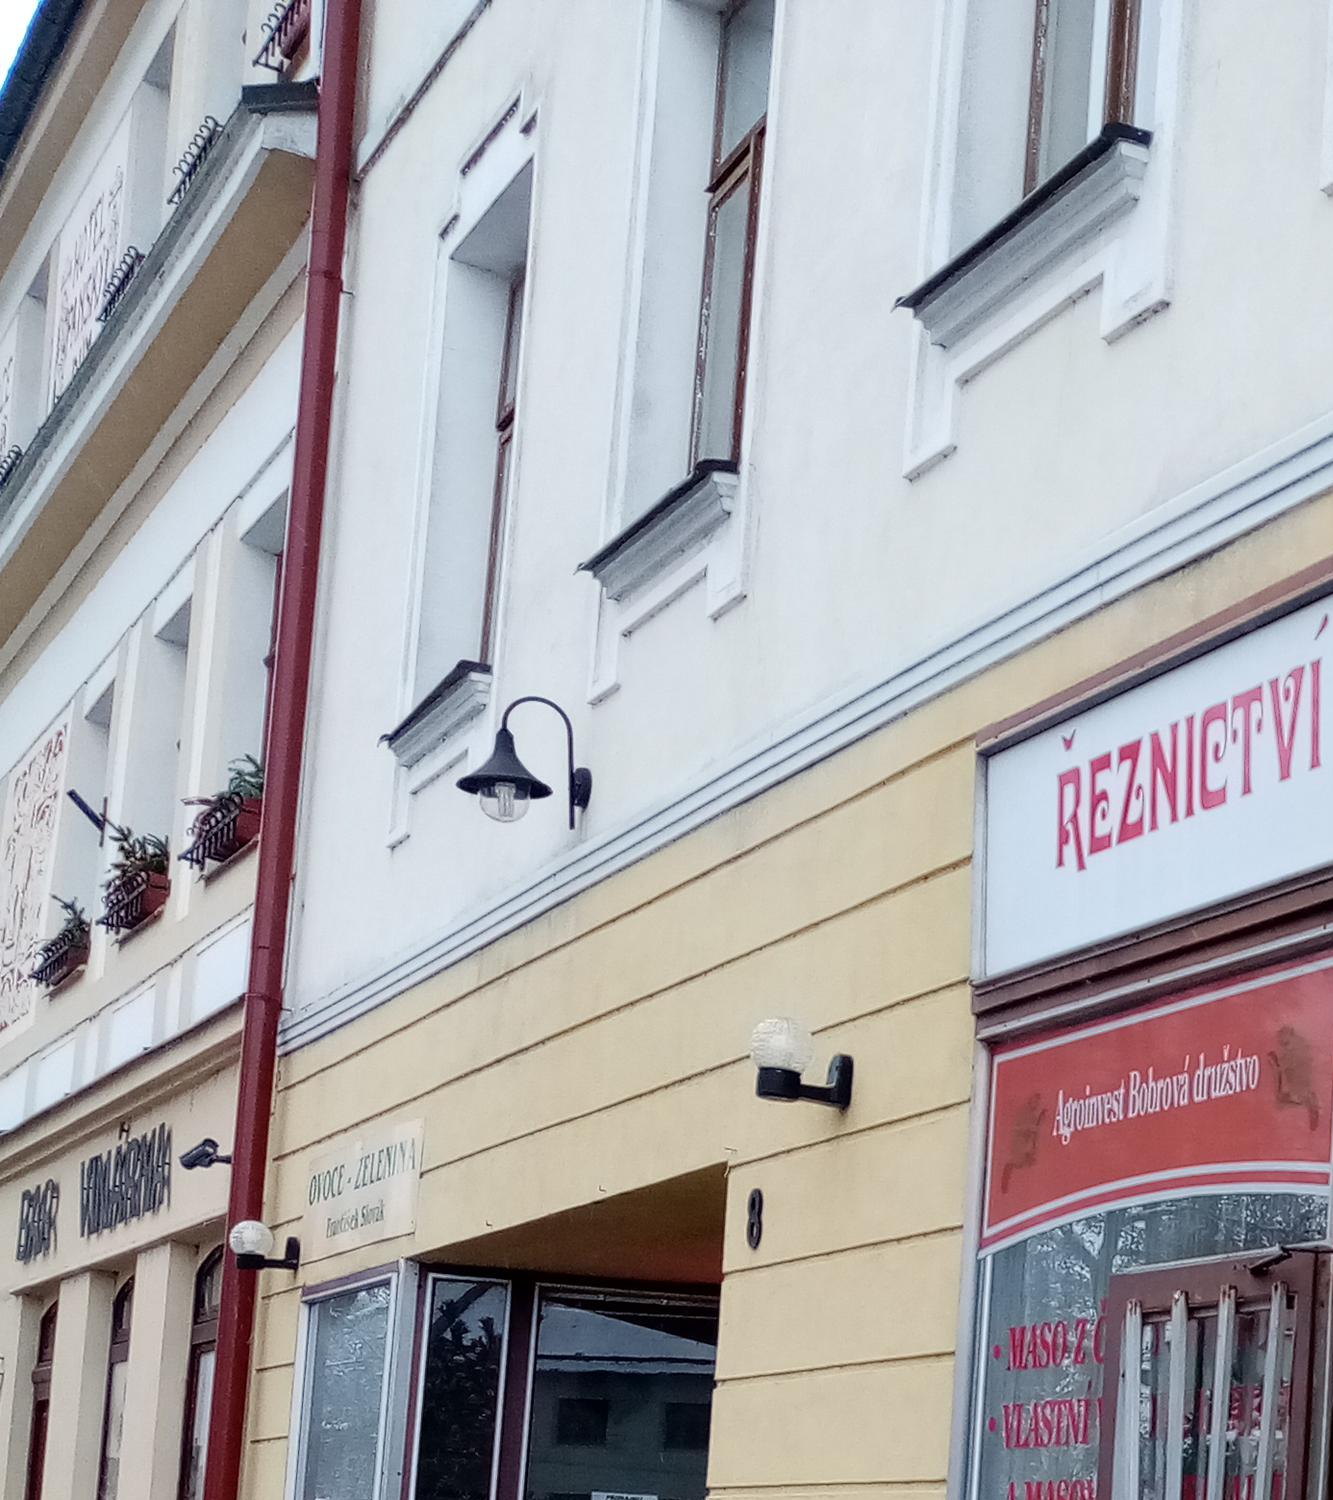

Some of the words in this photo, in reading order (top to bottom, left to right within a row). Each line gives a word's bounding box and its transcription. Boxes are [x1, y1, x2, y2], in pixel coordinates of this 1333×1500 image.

[1055, 613, 1329, 872] ŘEZNICTVÍ
[1052, 1080, 1127, 1145] Agroinvest
[1127, 1055, 1189, 1119] Bobrová
[1193, 1044, 1260, 1106] družstvo
[308, 1164, 345, 1206] OVOCE
[354, 1138, 416, 1190] ZELENINA
[1008, 1321, 1068, 1371] MASO
[1073, 1319, 1089, 1365] Z
[1003, 1380, 1093, 1449] VLASTNÍ
